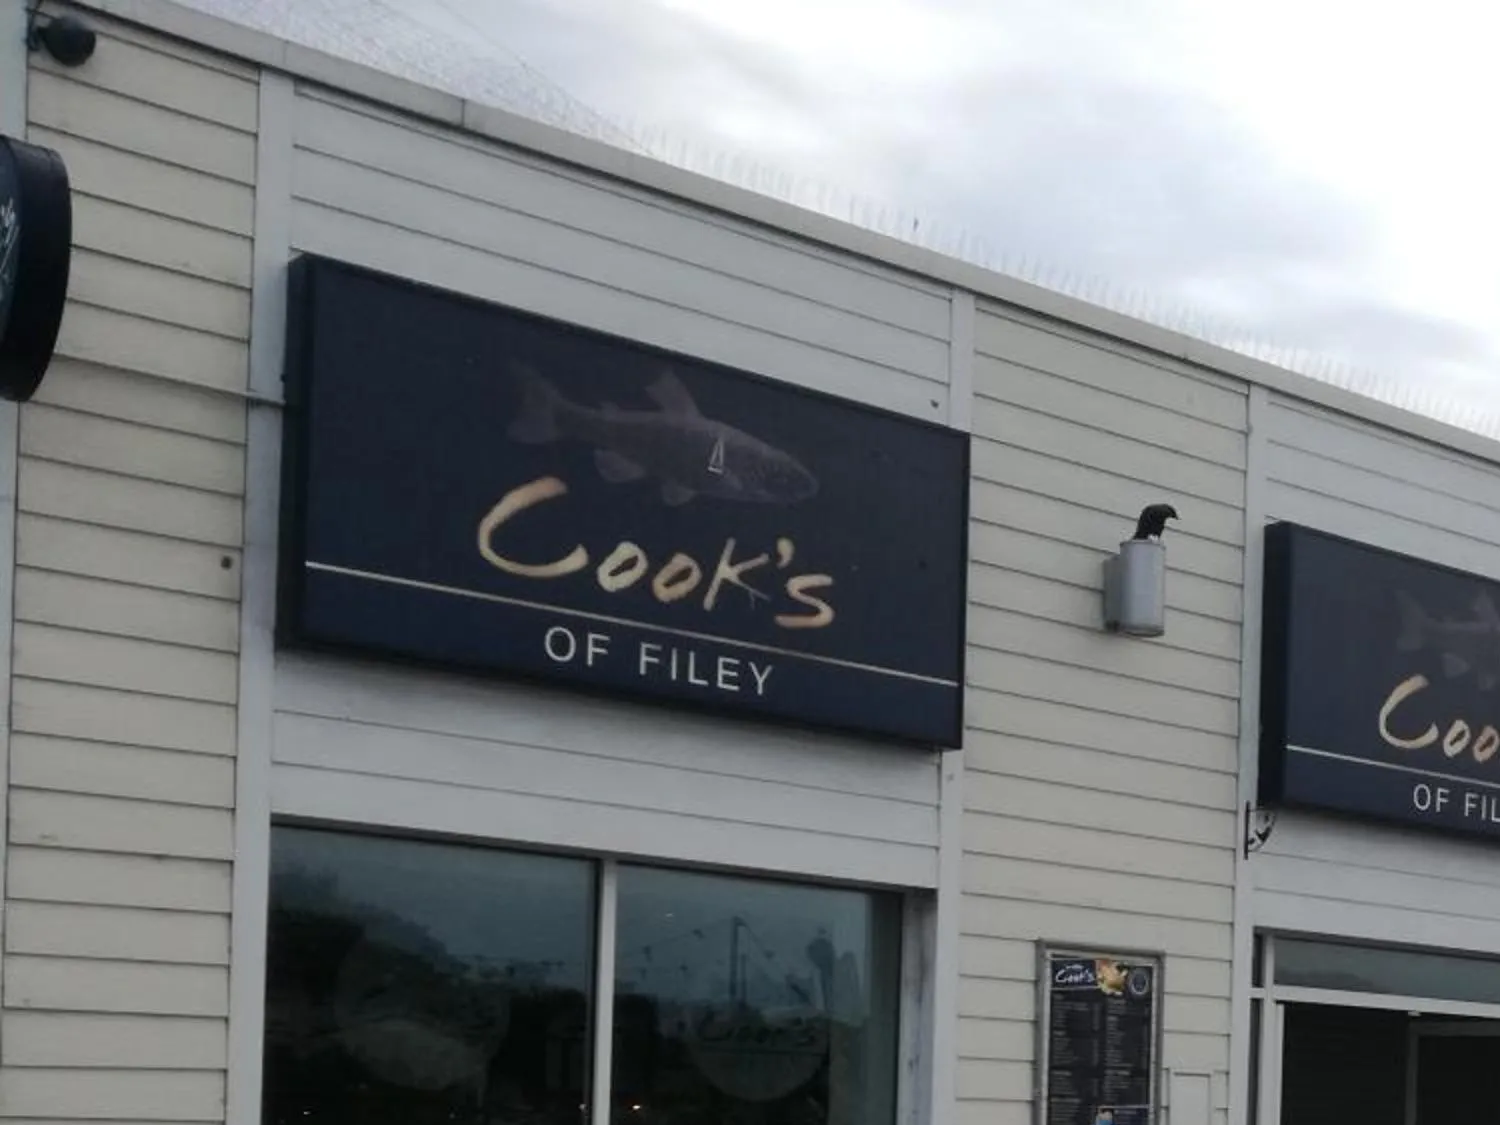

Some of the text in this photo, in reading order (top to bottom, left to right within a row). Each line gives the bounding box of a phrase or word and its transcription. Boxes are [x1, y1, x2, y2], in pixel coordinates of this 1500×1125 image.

[477, 476, 835, 628] Cook's
[543, 626, 773, 697] OF FILEY
[1412, 783, 1450, 812] OF
